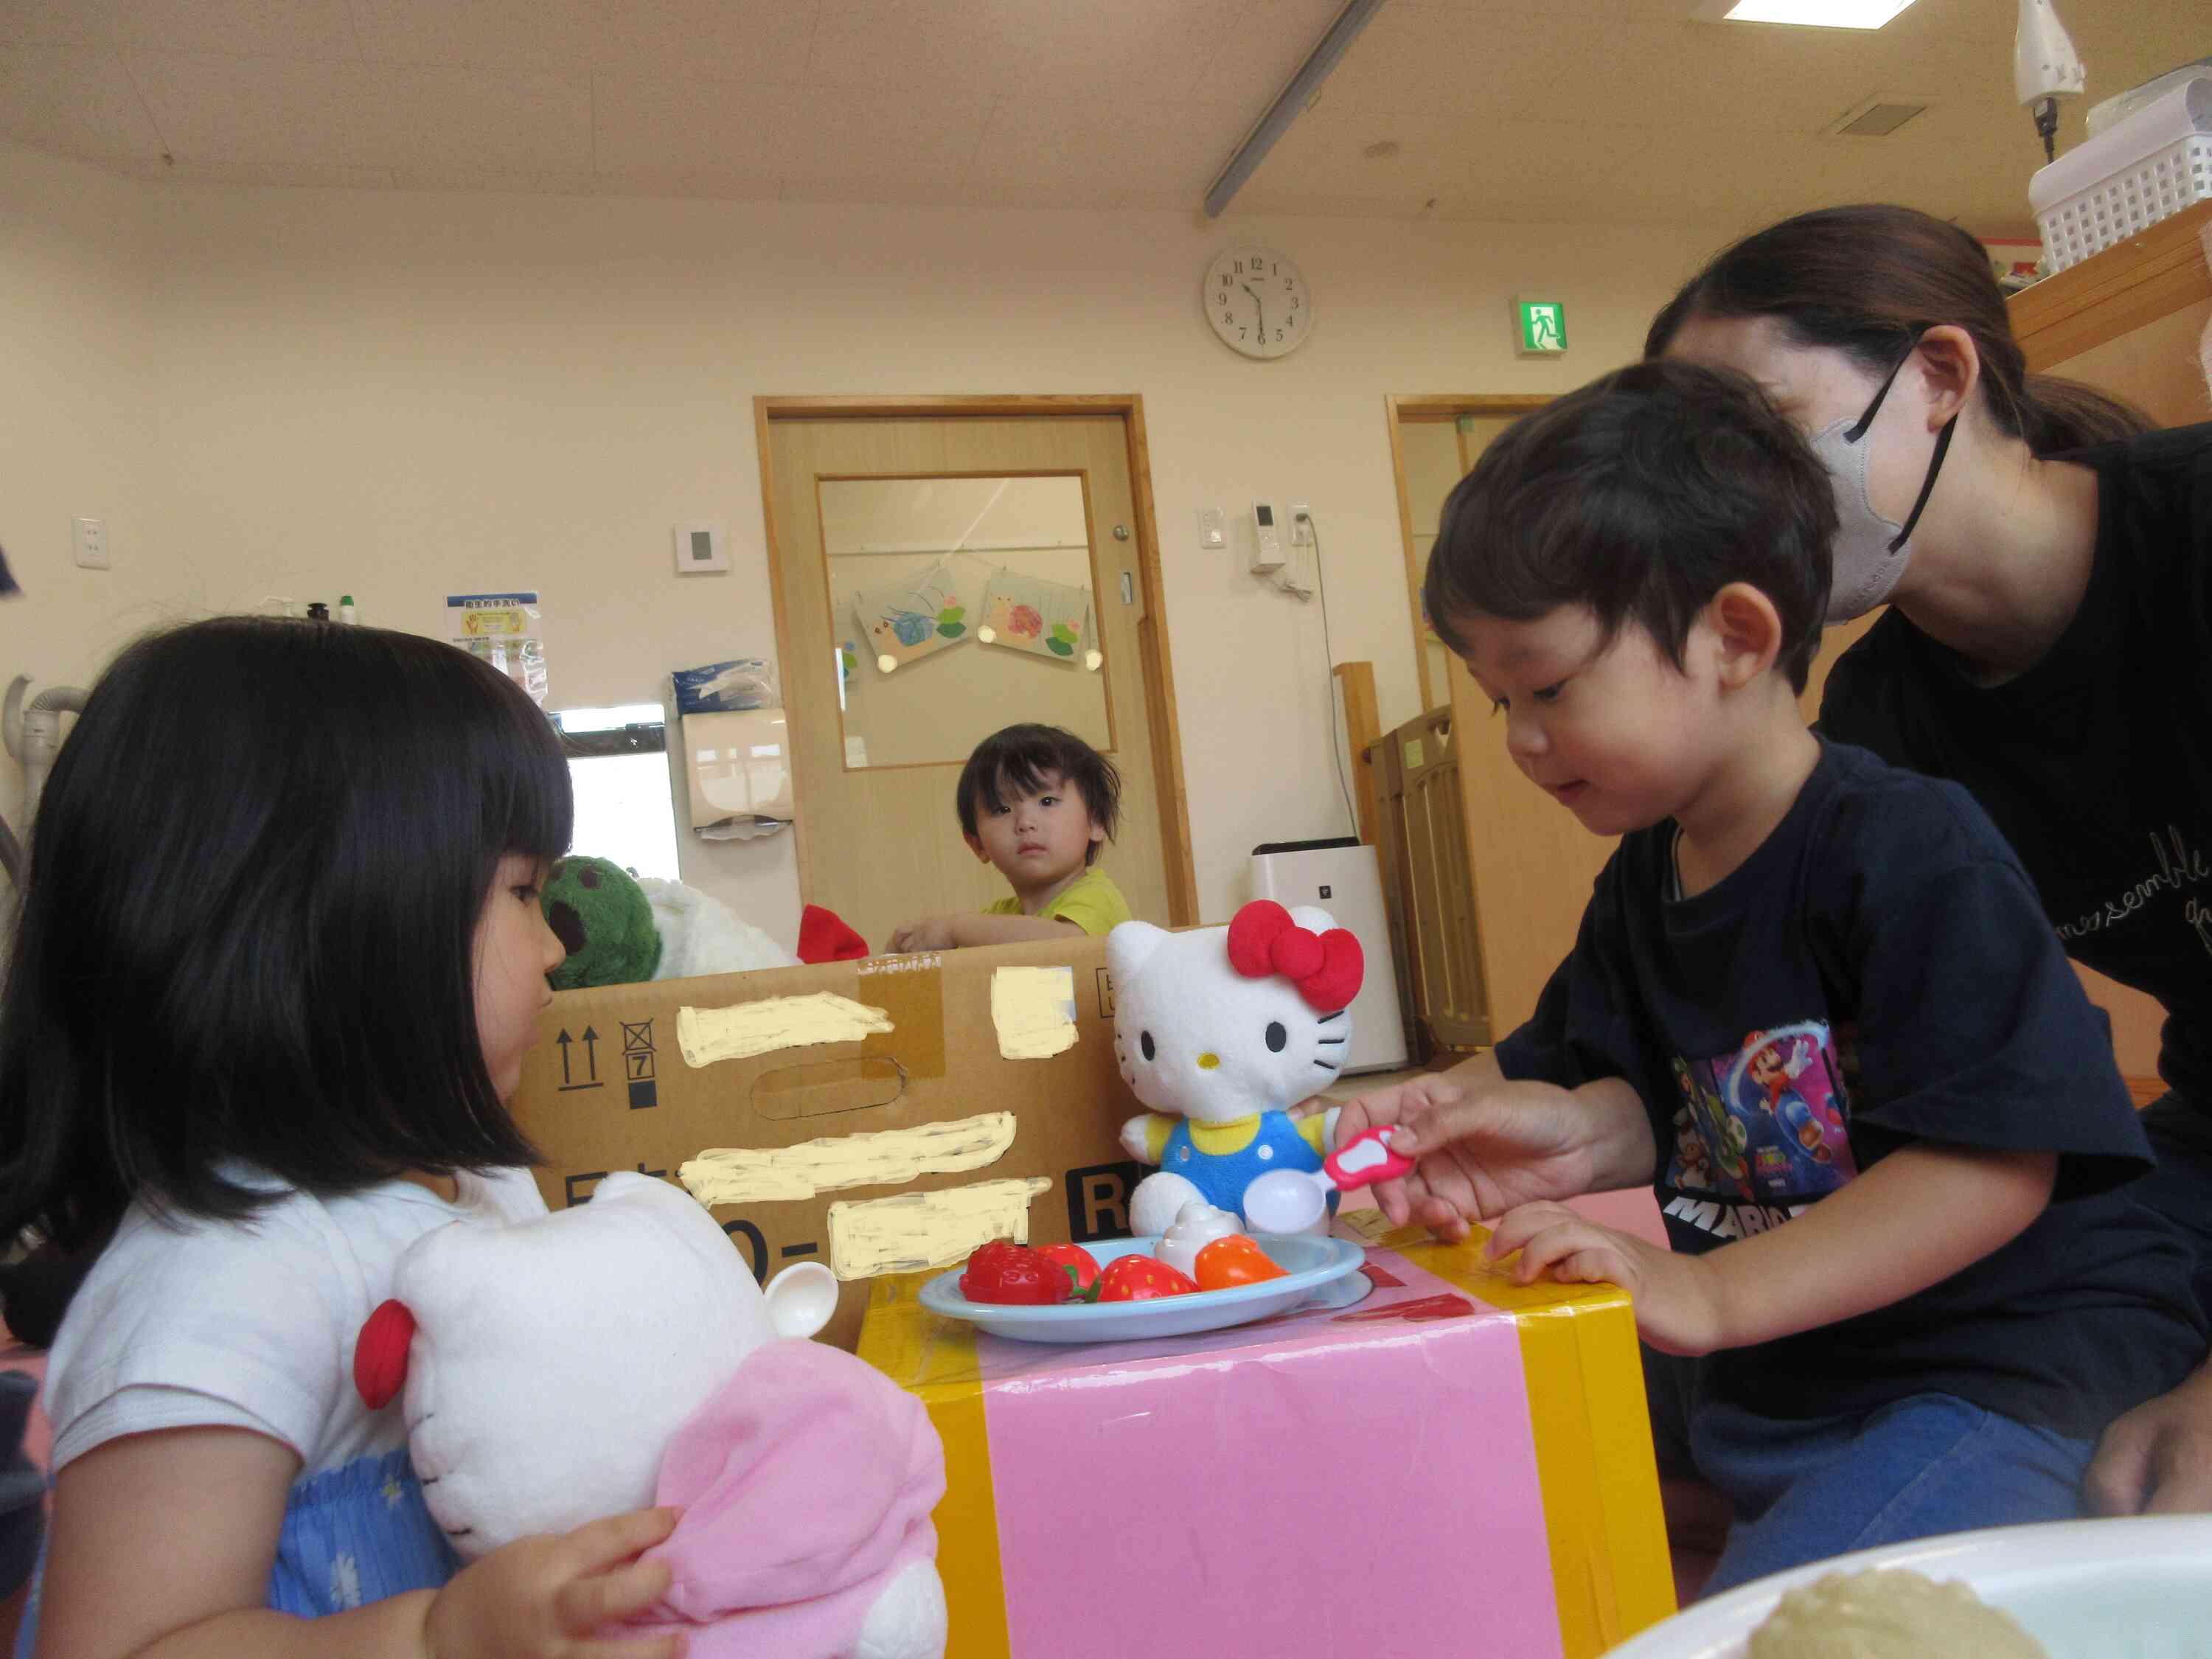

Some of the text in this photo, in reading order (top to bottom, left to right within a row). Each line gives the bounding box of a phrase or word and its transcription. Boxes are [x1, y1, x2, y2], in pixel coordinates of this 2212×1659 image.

[1234, 260, 1244, 274] 11
[1251, 257, 1263, 271] 12
[1272, 262, 1278, 276] 1
[1221, 273, 1234, 287] 10
[1285, 277, 1293, 291] 2
[1218, 292, 1228, 306] 9
[1291, 296, 1299, 310] 3
[1225, 312, 1234, 325] 8
[1285, 315, 1293, 327] 4
[1239, 327, 1247, 340] 7
[1257, 332, 1266, 346] 6
[1276, 328, 1284, 342] 5
[632, 1055, 647, 1076] 7
